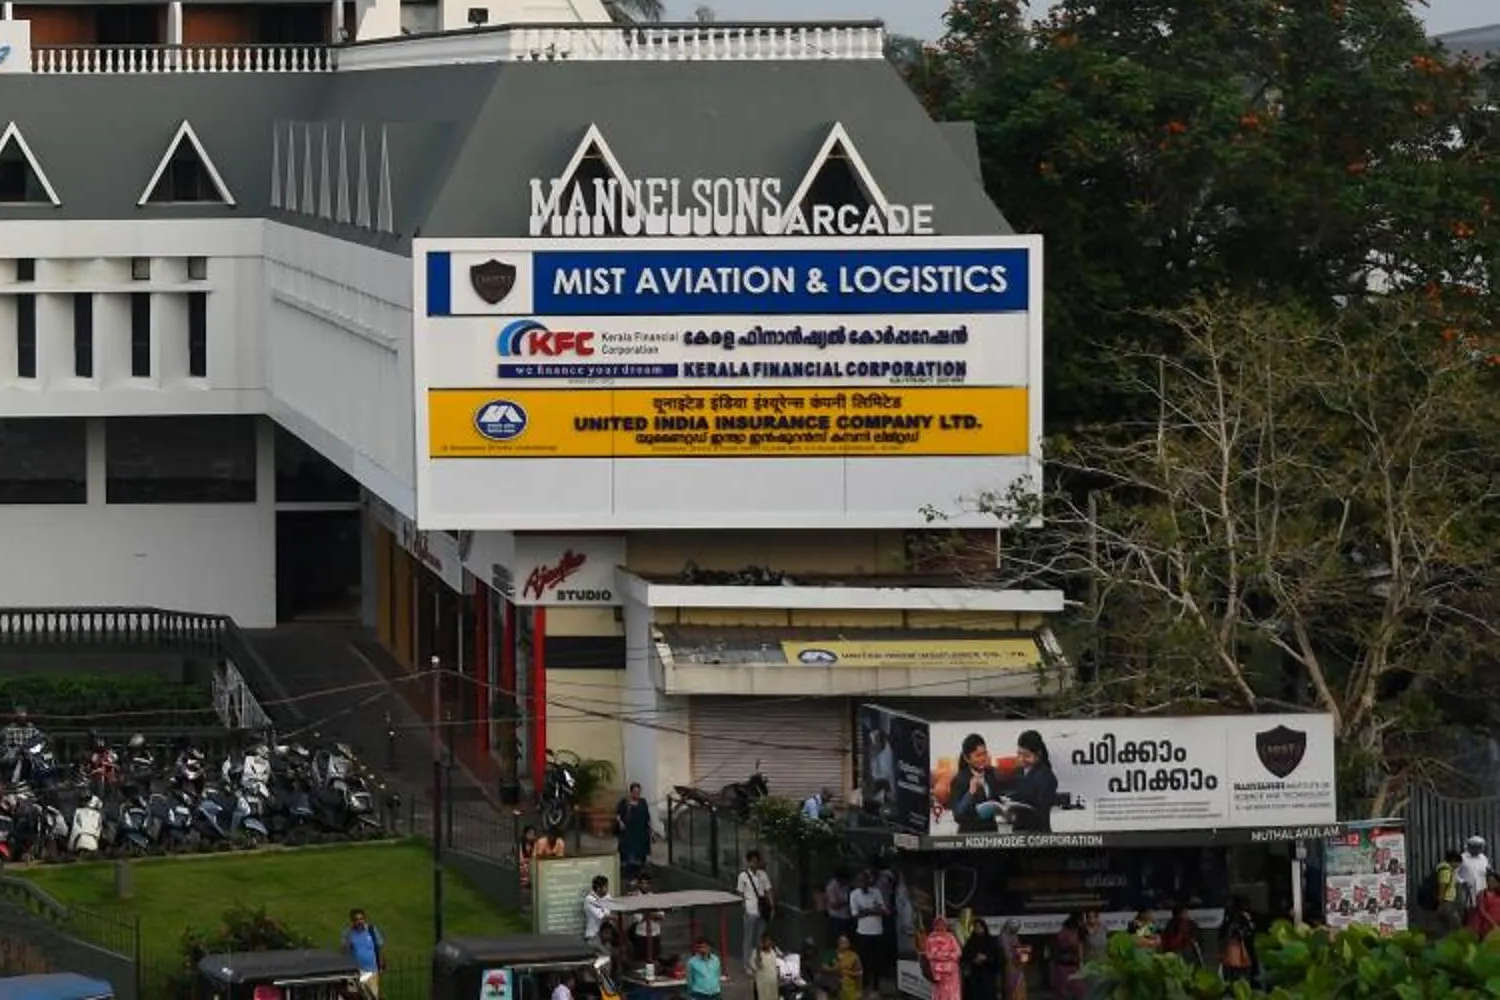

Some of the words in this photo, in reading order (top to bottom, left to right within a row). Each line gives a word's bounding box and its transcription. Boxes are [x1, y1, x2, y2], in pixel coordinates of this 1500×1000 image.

[529, 178, 784, 235] MANUELSONS
[785, 204, 933, 235] ARCADE
[553, 267, 627, 294] MIST
[635, 266, 796, 294] AVIATION
[805, 266, 829, 294] &
[840, 265, 1008, 293] LOGISTICS
[528, 331, 595, 356] KFC
[601, 332, 632, 342] Kerala
[634, 331, 679, 342] Financial
[601, 344, 660, 355] Corporation
[683, 361, 750, 378] KERALA
[752, 361, 845, 378] FINANCIAL
[846, 360, 967, 377] CORPORATION
[574, 416, 648, 431] UNITED
[654, 415, 709, 431] INDIA
[715, 415, 830, 430] INSURANCE
[836, 414, 932, 430] COMPANY
[939, 414, 983, 430] LTD.
[557, 589, 612, 600] STUDIO
[1071, 733, 1187, 765] പഠിക്കാം
[1108, 768, 1218, 793] പറക്കാം
[1028, 834, 1103, 847] CORPORATION
